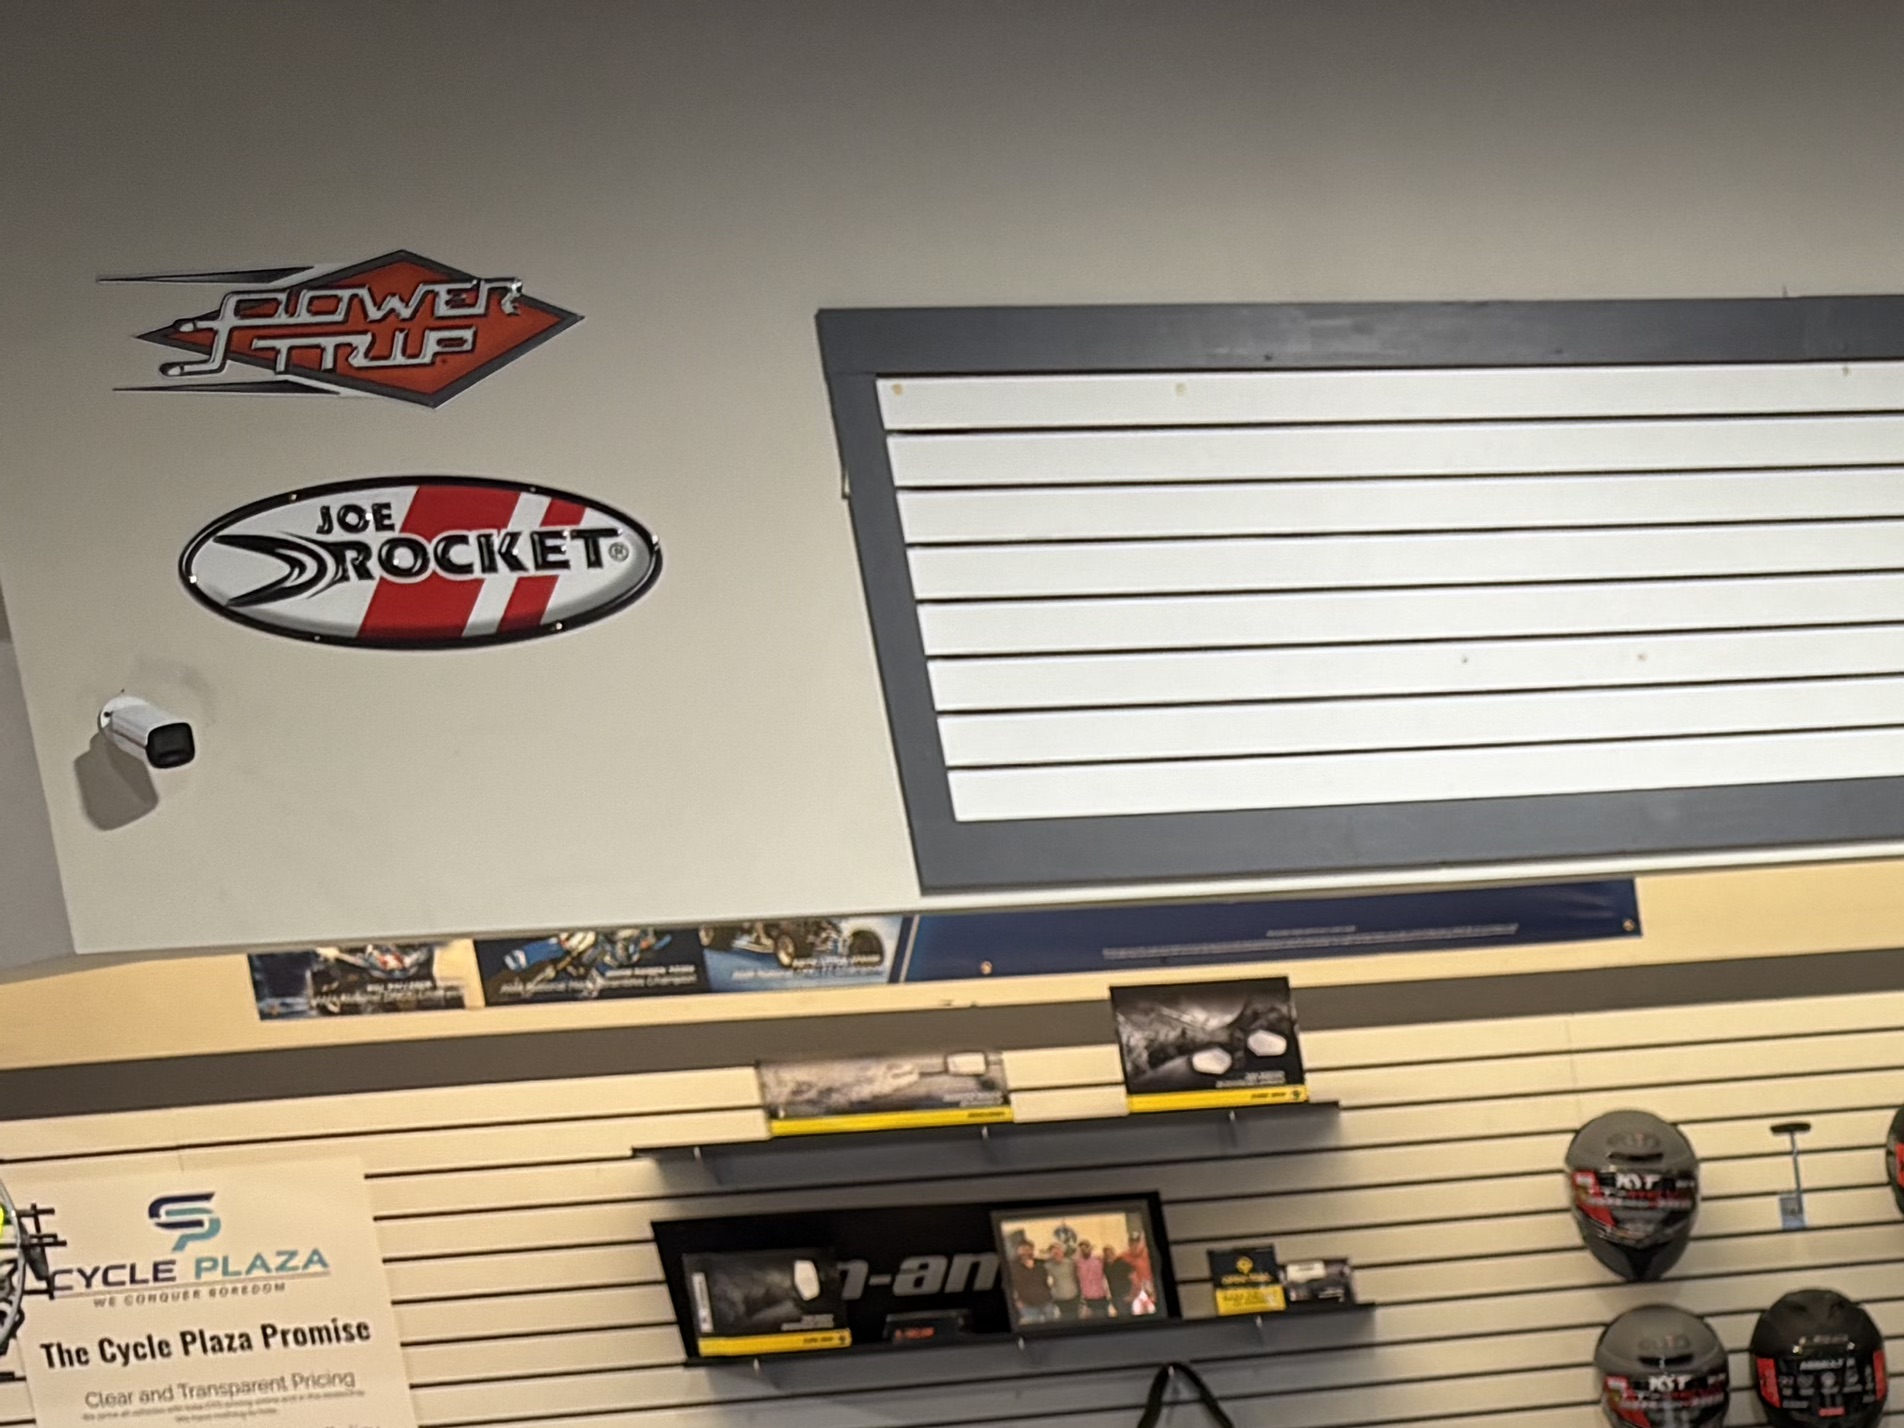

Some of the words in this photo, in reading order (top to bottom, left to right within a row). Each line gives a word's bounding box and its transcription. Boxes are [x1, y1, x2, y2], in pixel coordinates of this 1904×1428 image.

[316, 501, 395, 535] JOE
[194, 1248, 331, 1280] PLAZA
[93, 1297, 117, 1308] WE
[40, 1341, 90, 1369] The
[97, 1333, 173, 1367] Cycle
[179, 1328, 254, 1357] Plaza
[259, 1317, 372, 1350] Promise
[84, 1390, 134, 1410] Clear
[138, 1384, 175, 1403] and
[177, 1374, 287, 1402] Transparent
[291, 1370, 357, 1390] Pricing
